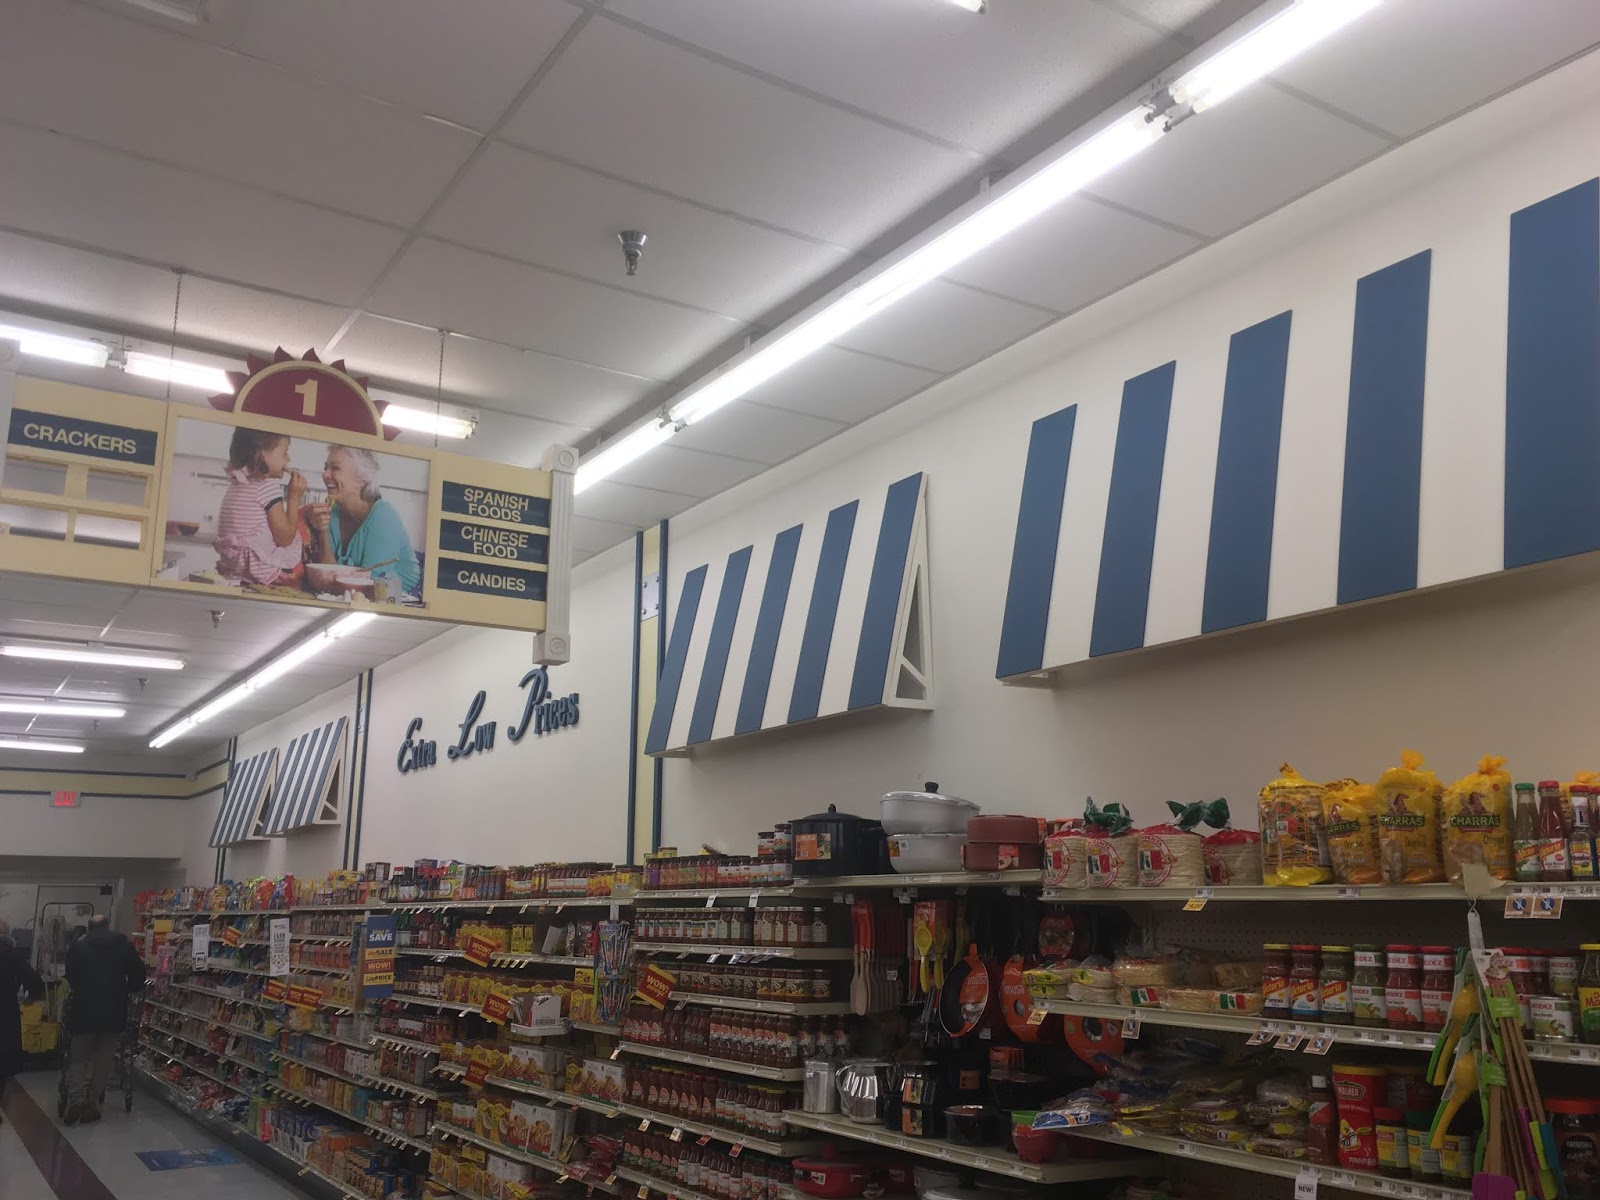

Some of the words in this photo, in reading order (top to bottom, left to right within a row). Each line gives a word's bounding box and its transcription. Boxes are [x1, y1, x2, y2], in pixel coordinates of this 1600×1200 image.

[294, 378, 318, 417] 1
[23, 423, 137, 455] CRACKERS
[463, 488, 529, 512] SPANISH
[468, 502, 522, 523] FOODS
[460, 525, 529, 548] CHINESE
[473, 541, 518, 559] FOOD
[457, 570, 526, 592] CANDIES
[397, 717, 437, 773] Extra
[447, 690, 497, 759] Low
[507, 665, 580, 741] Prices
[1451, 816, 1500, 826] CHARRAS
[369, 933, 393, 942] SAVE
[367, 961, 391, 970] WOW!
[646, 975, 670, 993] WOW!
[1298, 1185, 1314, 1194] NEW!
